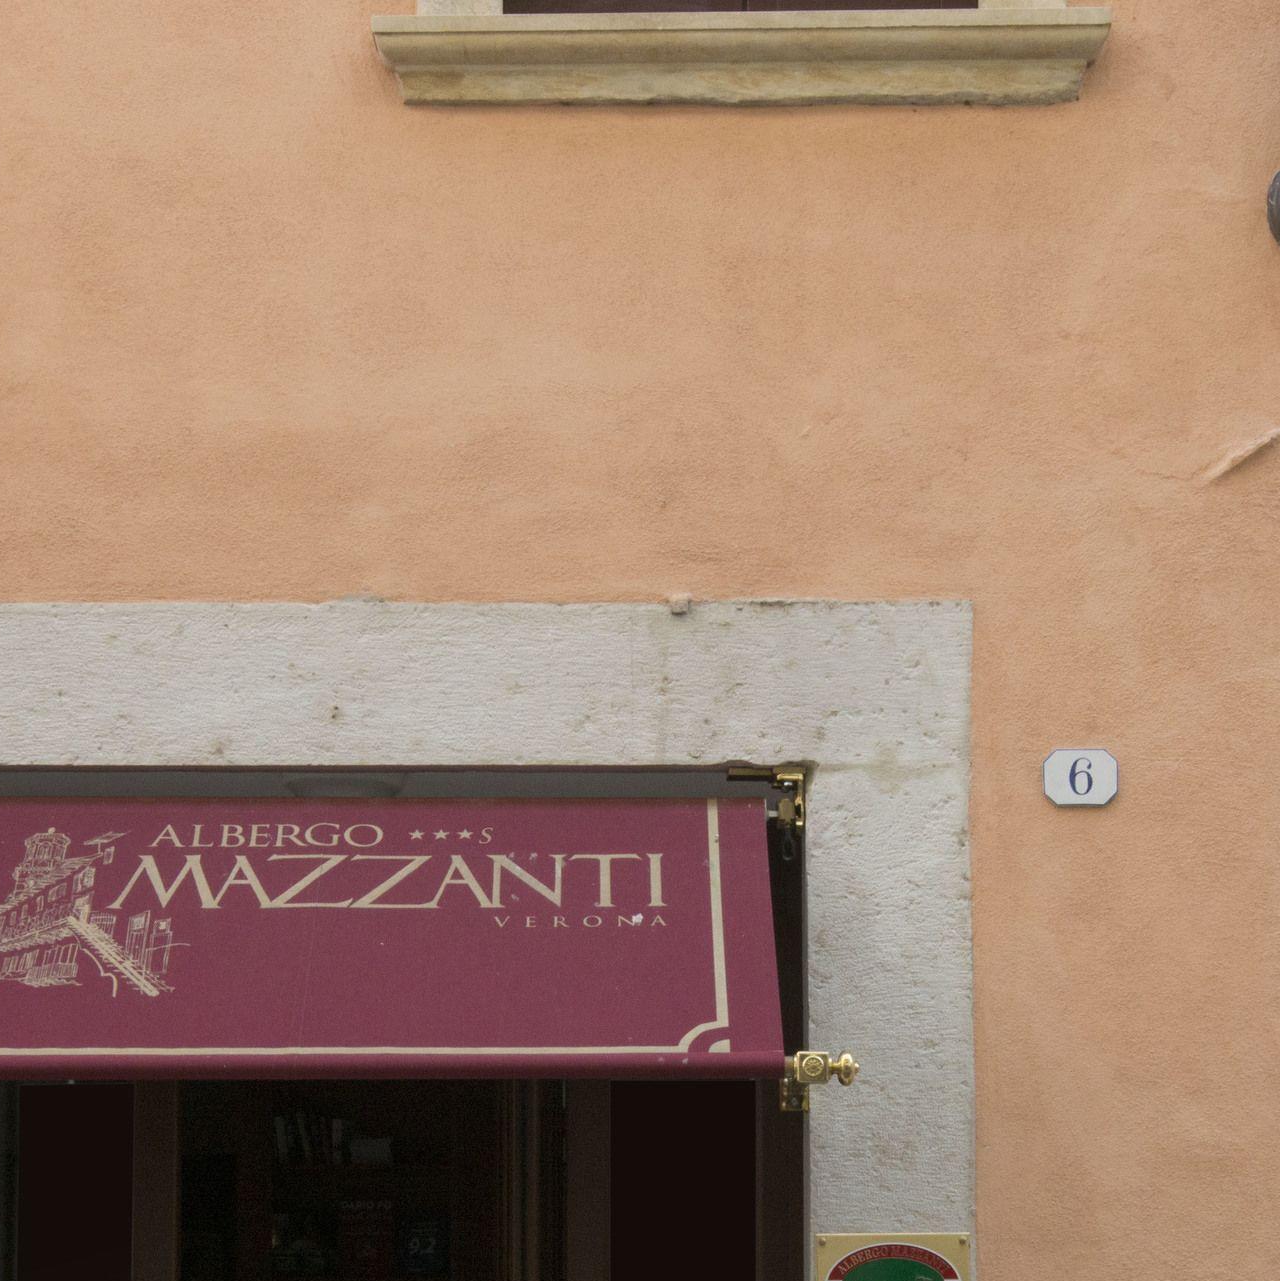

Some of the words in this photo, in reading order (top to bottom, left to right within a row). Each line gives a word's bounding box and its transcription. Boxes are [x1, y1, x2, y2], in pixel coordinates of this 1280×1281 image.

[1069, 757, 1093, 796] 6
[150, 823, 384, 848] ALBERGO
[110, 853, 666, 909] MAZZANTI
[493, 914, 668, 928] VERONA
[838, 1246, 889, 1275] ALBERGO
